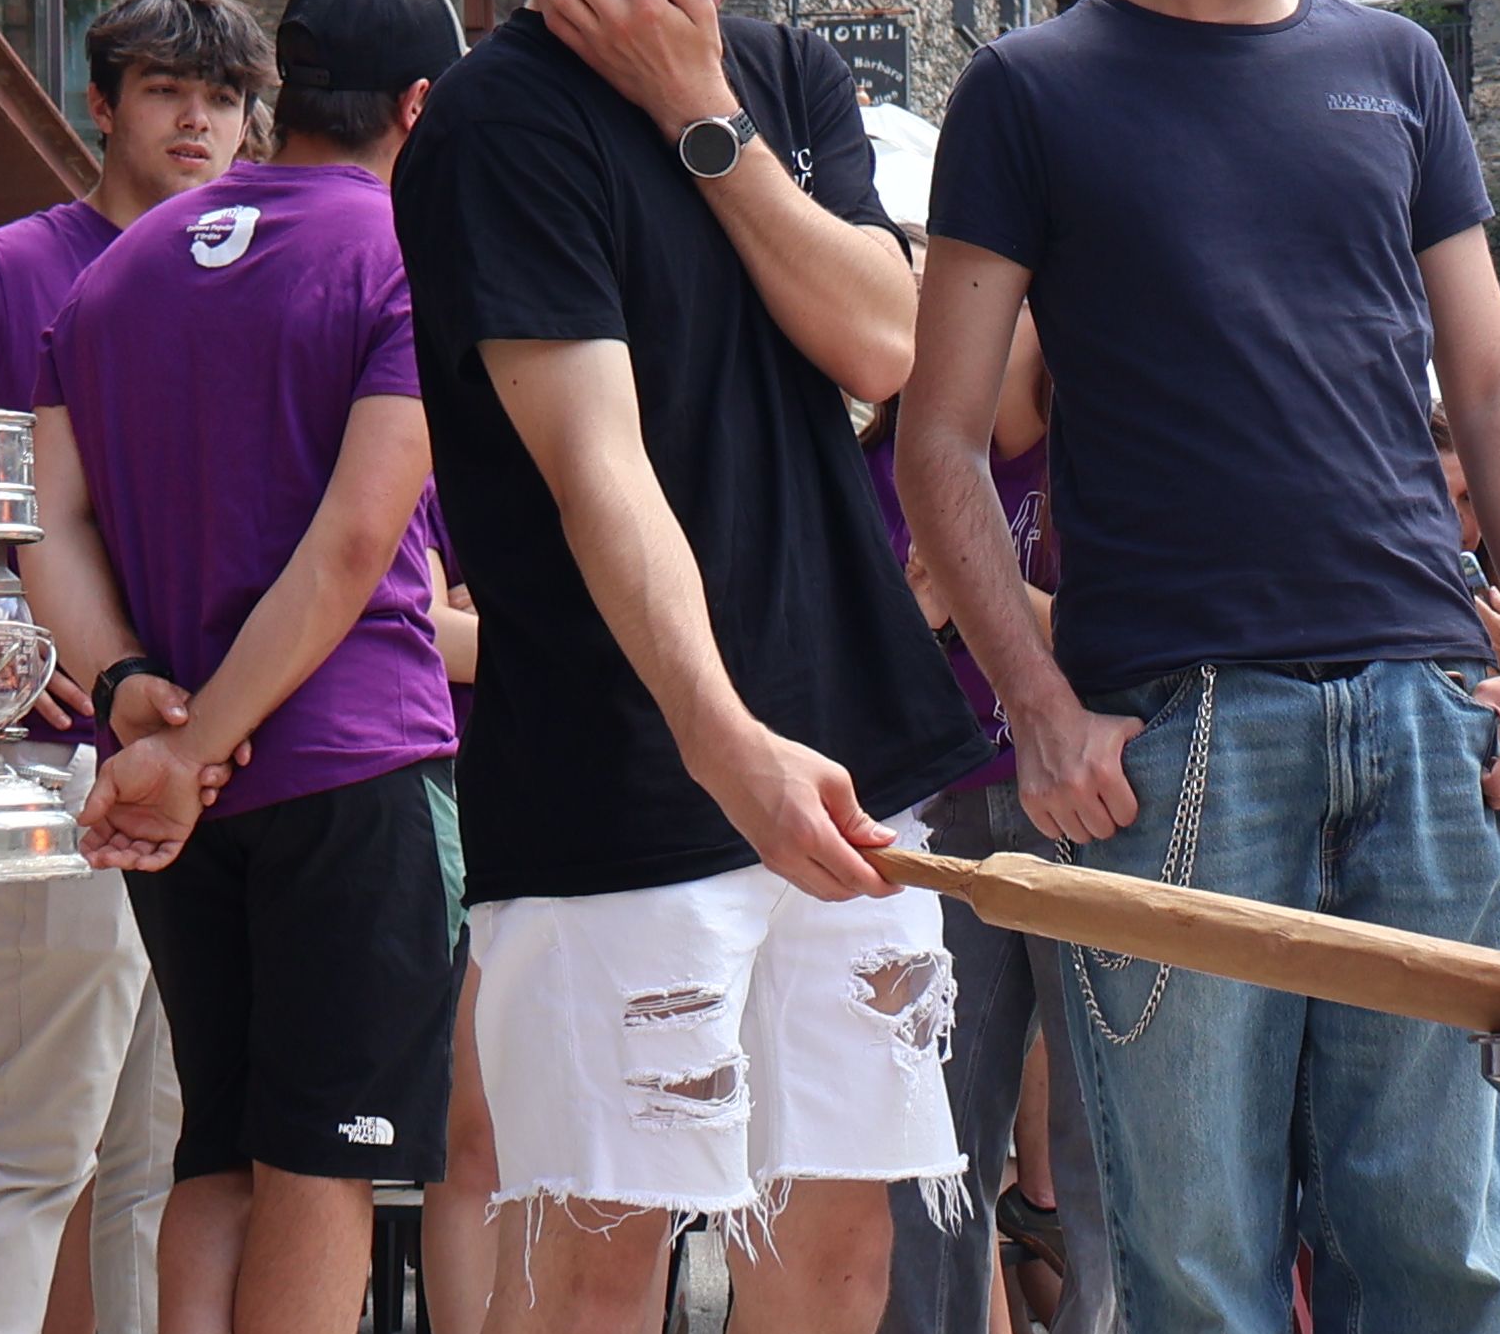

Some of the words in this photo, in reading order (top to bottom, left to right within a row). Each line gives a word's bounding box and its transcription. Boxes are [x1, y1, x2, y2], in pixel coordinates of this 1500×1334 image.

[815, 23, 901, 43] HOTEL
[354, 1115, 376, 1126] THE
[338, 1123, 376, 1135] NORTH
[348, 1132, 376, 1145] FACE
